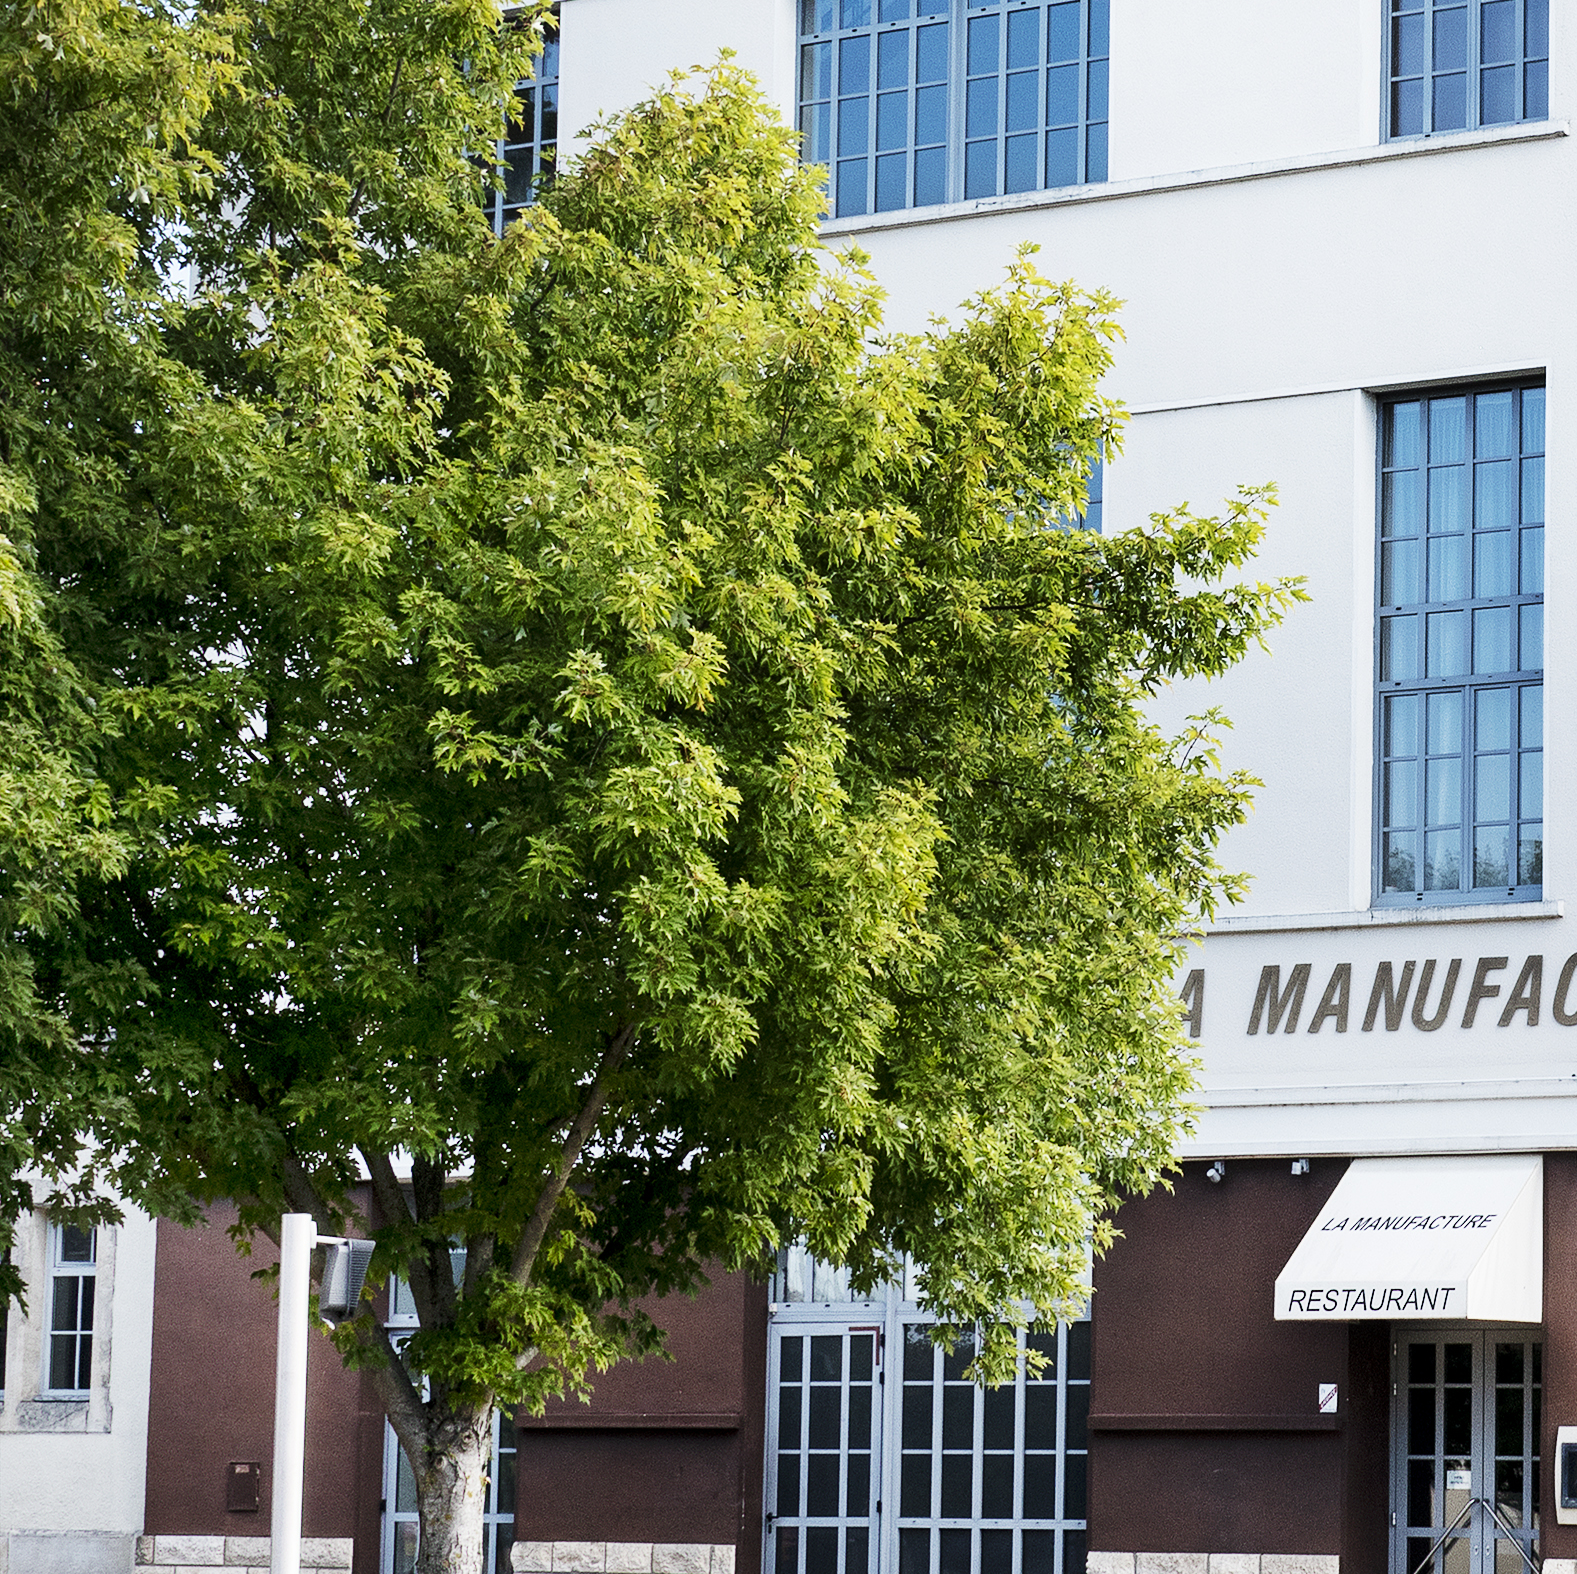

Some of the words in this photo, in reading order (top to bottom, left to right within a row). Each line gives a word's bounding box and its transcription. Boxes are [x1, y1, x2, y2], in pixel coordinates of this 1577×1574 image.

[1321, 1217, 1349, 1231] LA
[1350, 1214, 1497, 1231] MANUFACTURE
[1288, 1287, 1456, 1313] RESTAURANT
